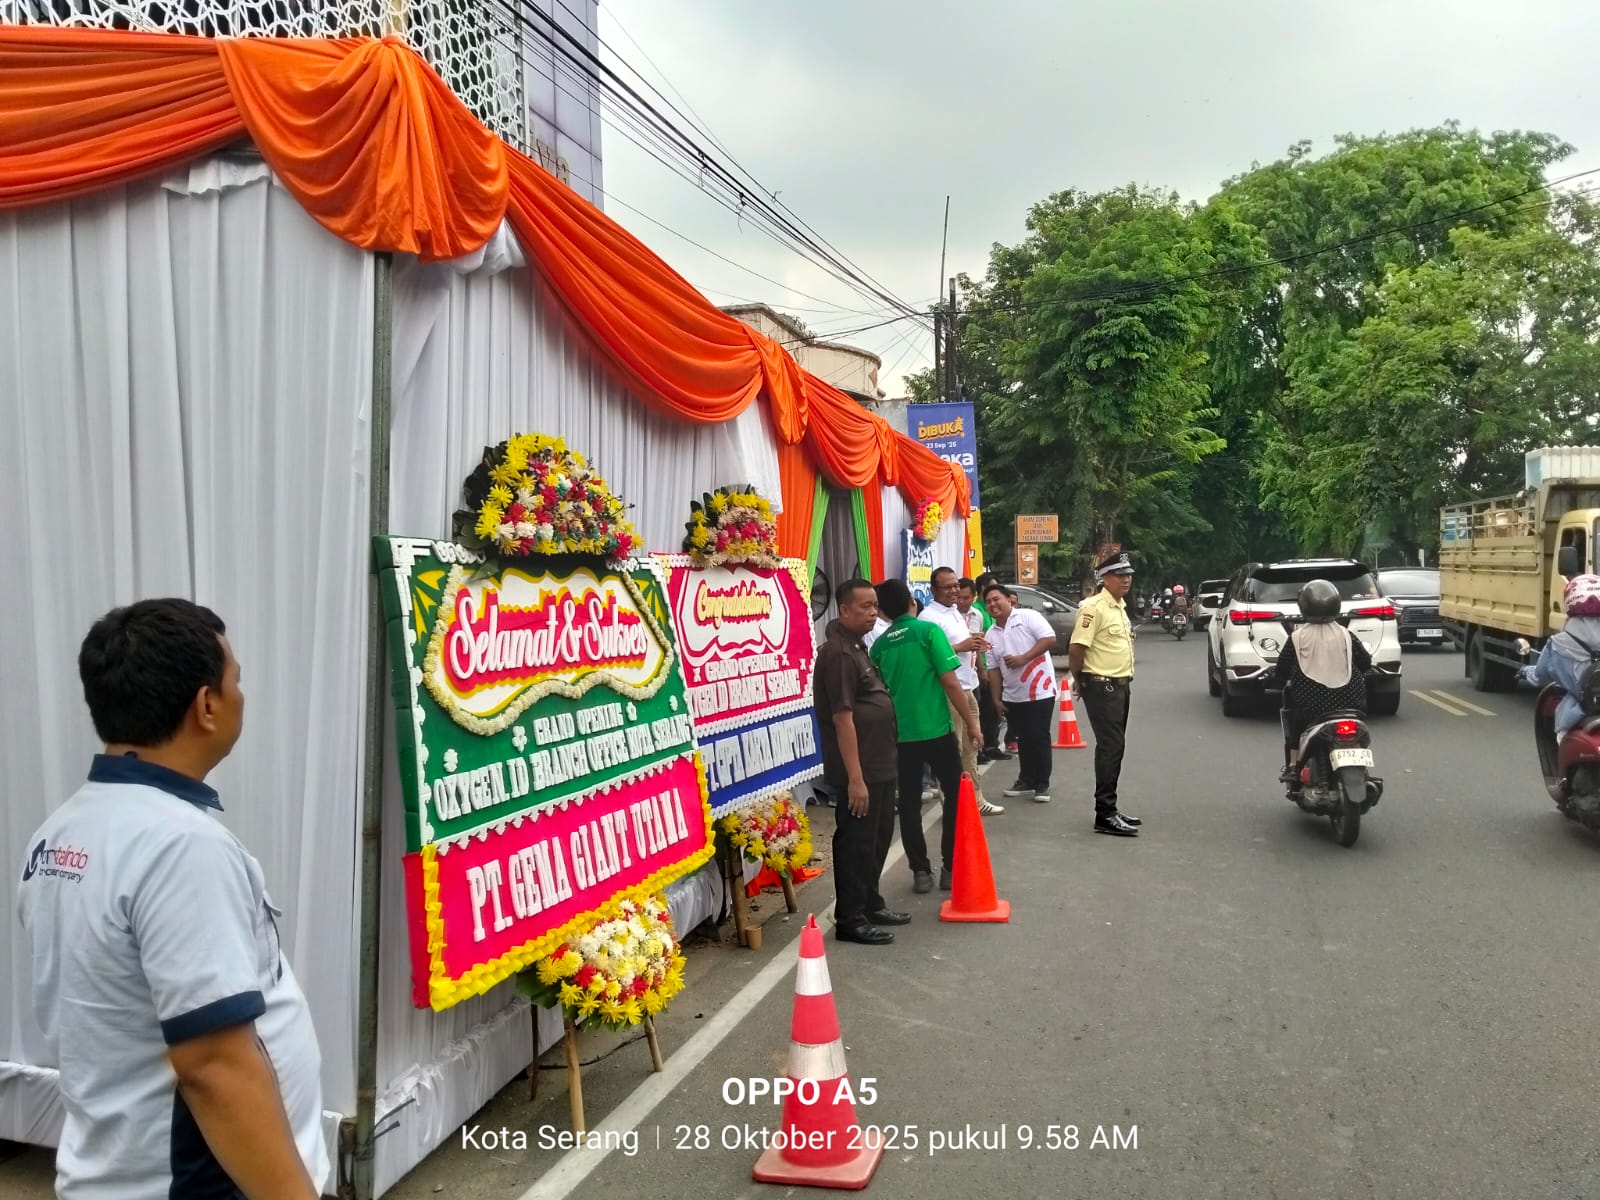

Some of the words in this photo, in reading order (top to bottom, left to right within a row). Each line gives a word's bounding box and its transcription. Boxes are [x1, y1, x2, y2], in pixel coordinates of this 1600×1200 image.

[918, 419, 963, 440] DIBUKA
[450, 596, 559, 680] Selamat
[557, 599, 582, 663] &
[583, 597, 648, 661] Sukses
[705, 659, 739, 682] GRAND
[738, 653, 780, 676] OPENING
[727, 674, 768, 709] BRANCH
[766, 668, 801, 700] SERANG
[533, 713, 575, 746] GRAND
[576, 702, 624, 735] OPENING
[529, 740, 590, 791] BRANCH
[586, 730, 629, 772] OFFICE
[626, 723, 655, 760] KOTA
[651, 713, 692, 751] SERANG
[508, 836, 573, 920] GEMA
[570, 809, 632, 890] GIANT
[629, 788, 688, 859] UTAMA
